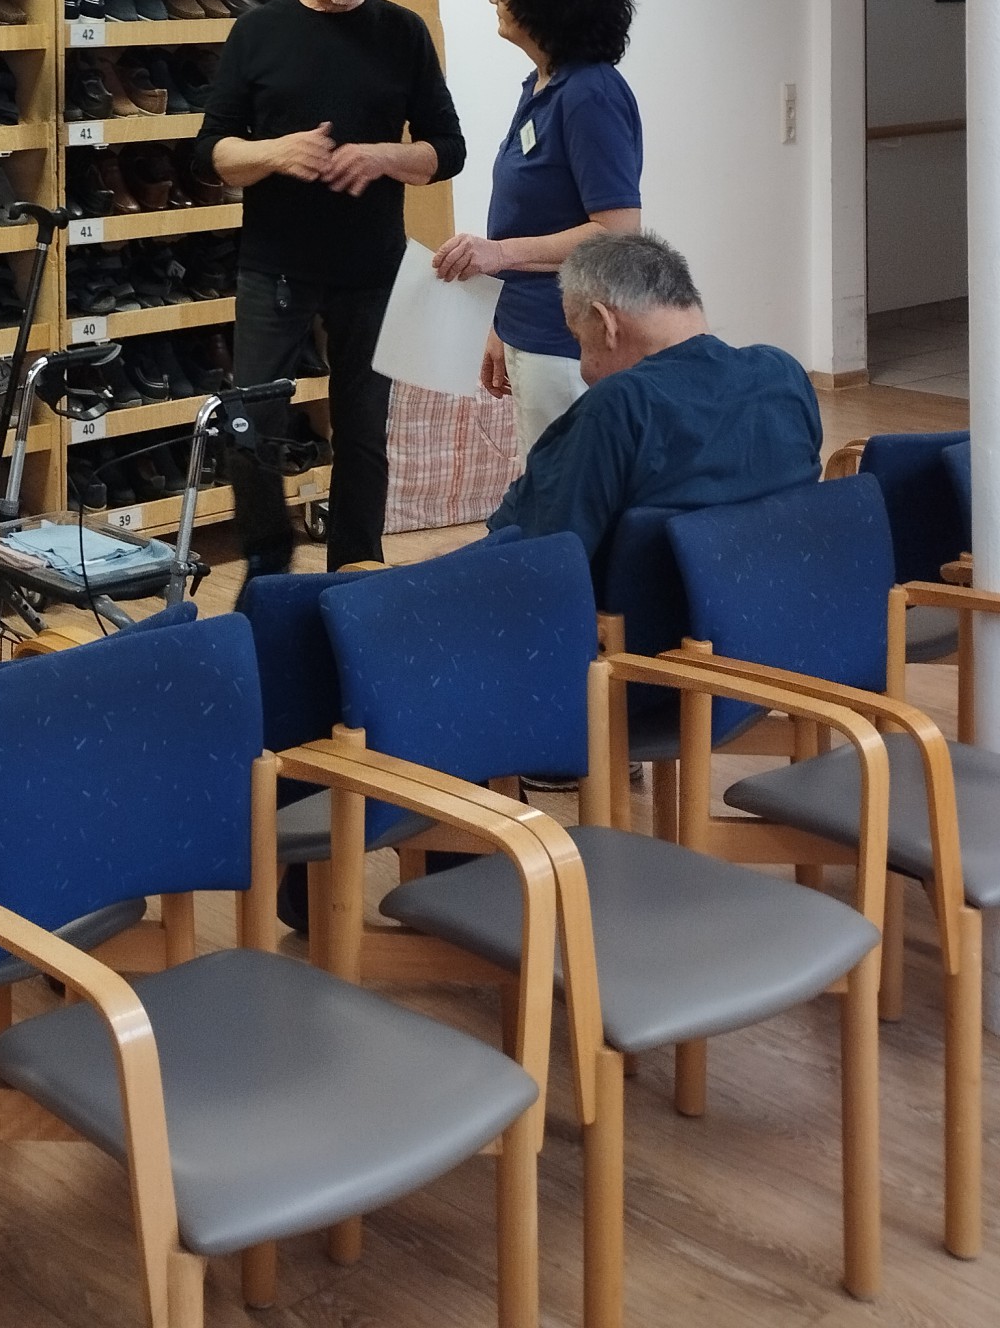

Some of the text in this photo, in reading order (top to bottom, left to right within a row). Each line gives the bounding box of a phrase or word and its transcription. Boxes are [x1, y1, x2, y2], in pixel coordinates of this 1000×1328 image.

[82, 29, 95, 41] 42
[80, 127, 93, 140] 41
[80, 225, 93, 238] 41
[83, 323, 96, 336] 40
[82, 423, 95, 435] 40
[119, 514, 131, 526] 39
